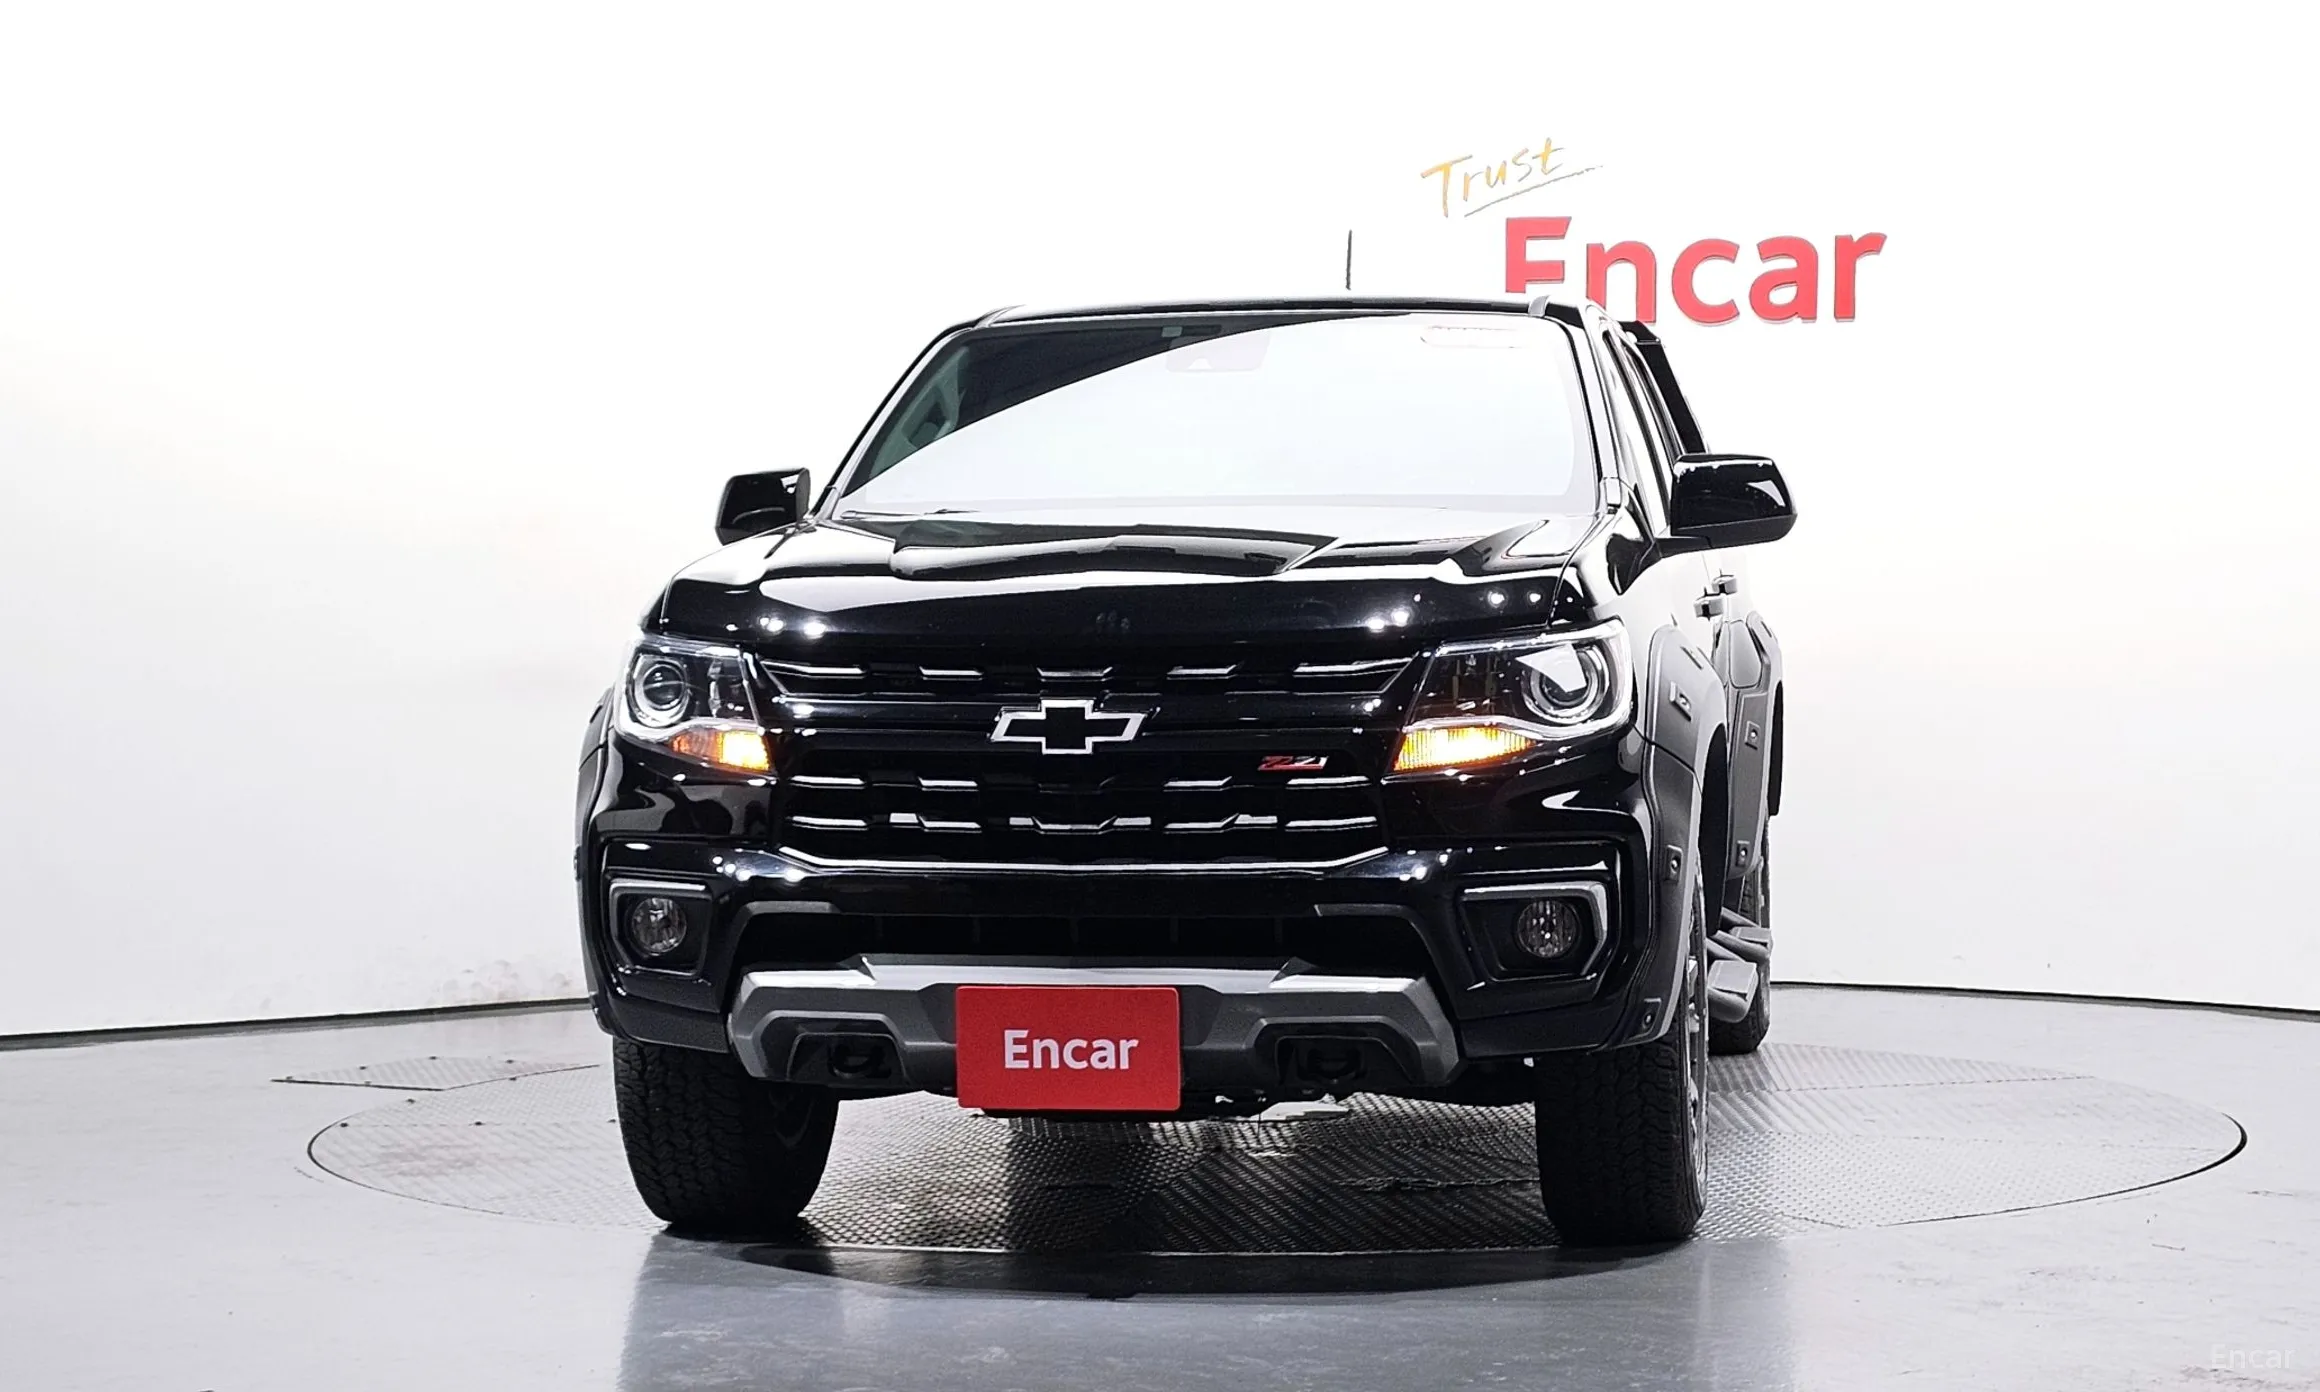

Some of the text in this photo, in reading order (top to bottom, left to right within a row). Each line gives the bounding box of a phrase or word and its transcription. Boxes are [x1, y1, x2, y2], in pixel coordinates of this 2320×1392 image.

[1420, 137, 1567, 218] Trust
[1504, 215, 1888, 326] Encar
[1003, 1029, 1140, 1070] Encar
